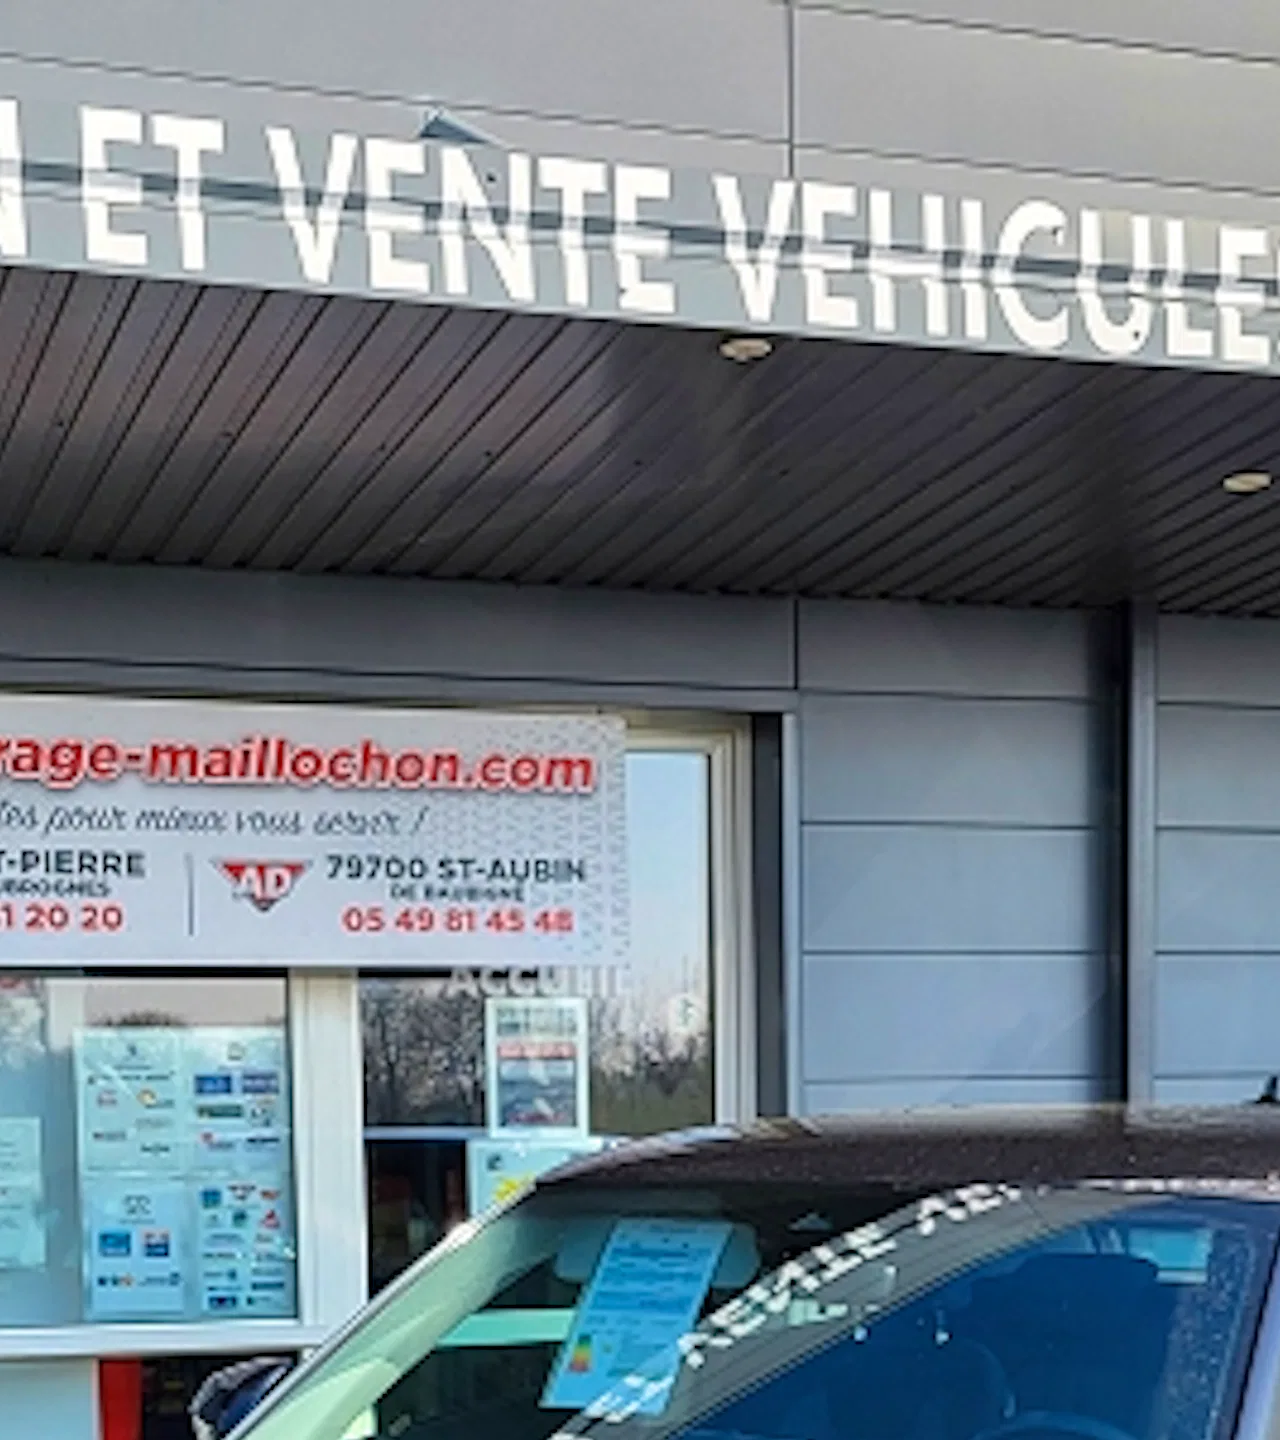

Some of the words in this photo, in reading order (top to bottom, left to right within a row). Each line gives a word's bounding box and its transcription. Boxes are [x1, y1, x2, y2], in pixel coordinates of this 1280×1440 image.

[78, 105, 226, 272] ET
[265, 127, 678, 317] VENTE
[43, 805, 126, 839] pour
[235, 810, 305, 834] vous
[235, 866, 293, 900] AD
[326, 854, 428, 880] 79700
[438, 859, 586, 882] ST-AUBIN
[24, 904, 68, 929] 20
[81, 905, 123, 930] 20
[343, 907, 385, 932] 05
[395, 907, 434, 932] 49
[445, 908, 475, 932] 81
